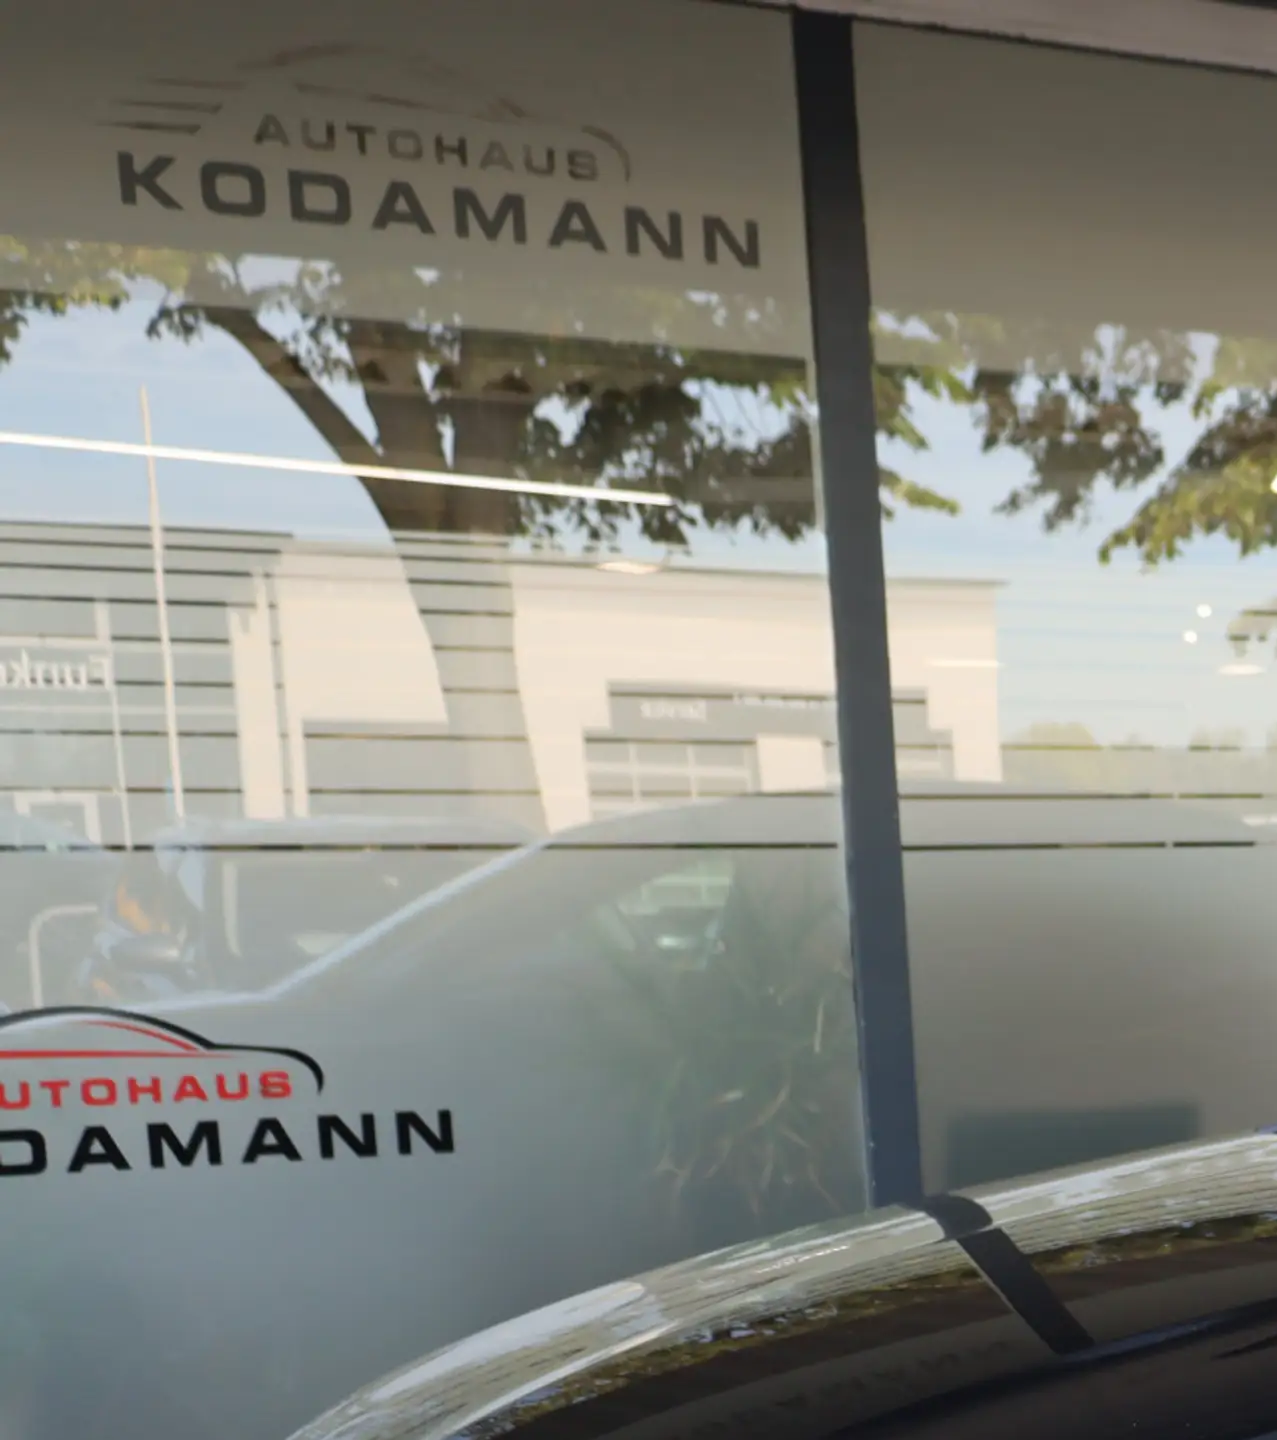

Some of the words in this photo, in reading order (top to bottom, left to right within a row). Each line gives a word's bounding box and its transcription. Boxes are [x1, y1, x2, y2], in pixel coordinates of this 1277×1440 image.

[253, 113, 600, 181] AUTOHAUS
[116, 149, 763, 270] KODAMANN
[0, 1070, 293, 1110] UTOHAUS
